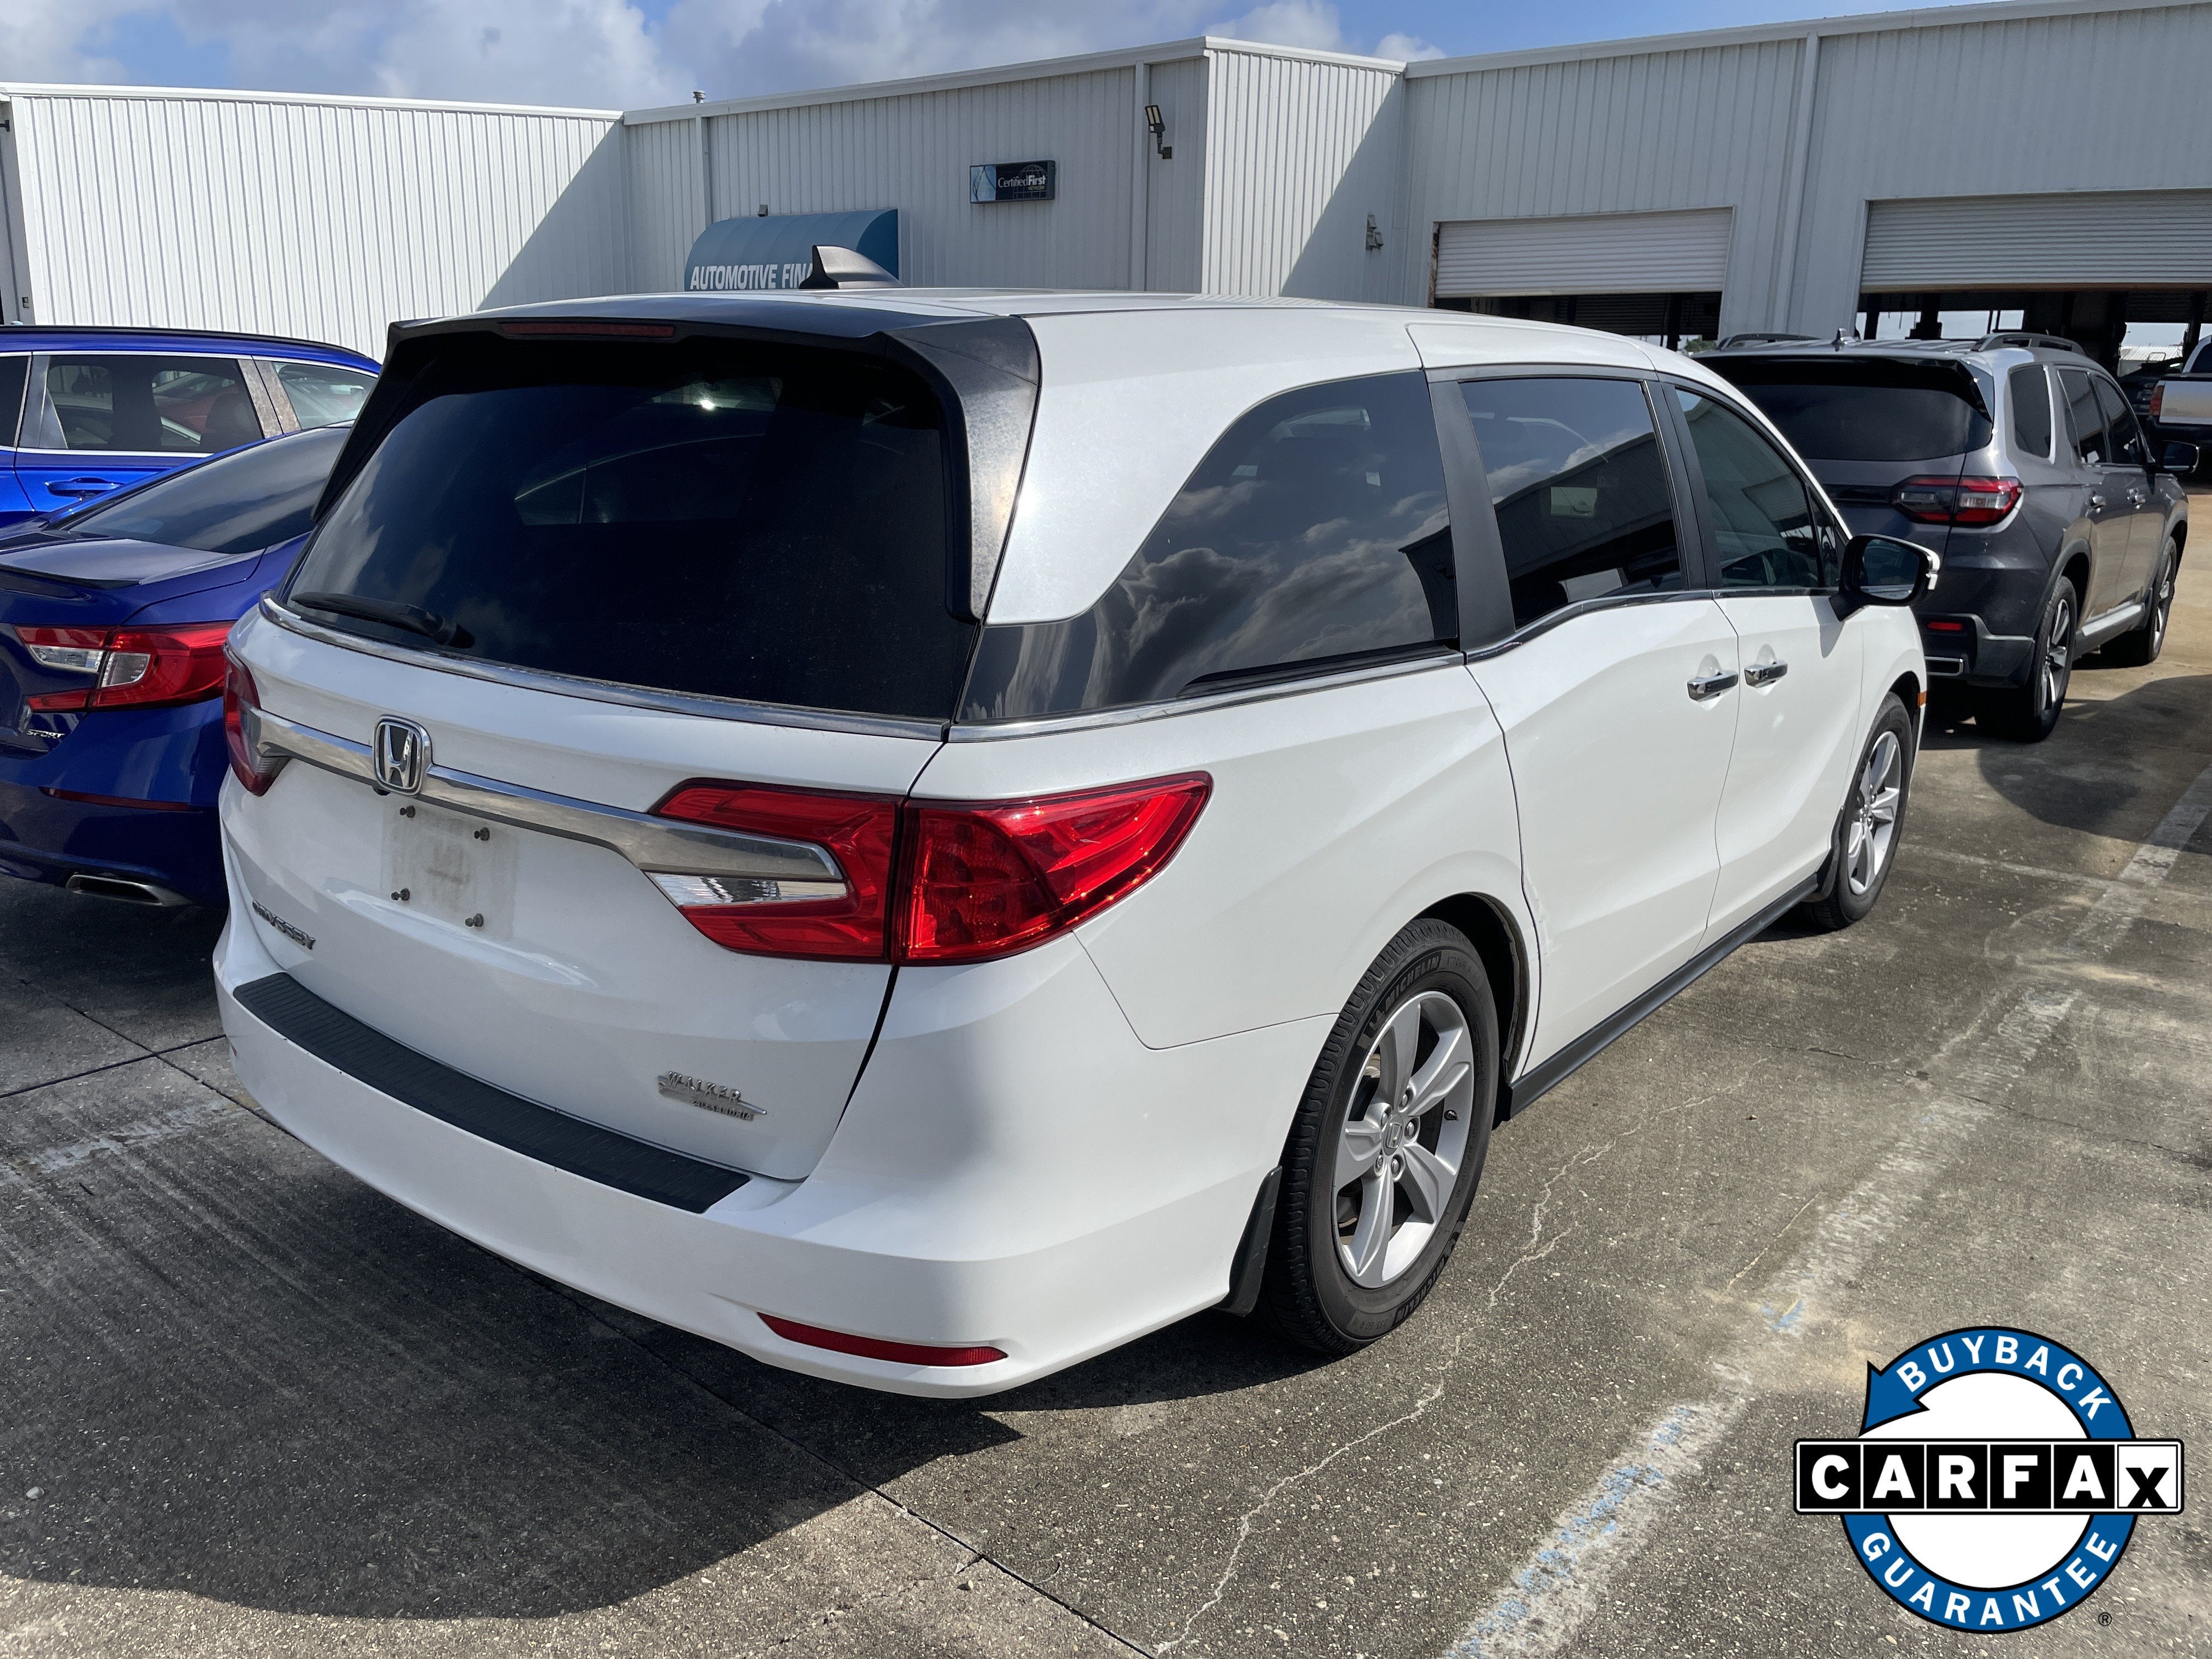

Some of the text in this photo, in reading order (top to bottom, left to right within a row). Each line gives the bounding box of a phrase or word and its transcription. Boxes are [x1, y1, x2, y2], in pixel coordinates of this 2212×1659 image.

[690, 264, 778, 290] AUTOMOTIVE
[26, 729, 65, 739] SPORT
[1385, 955, 1440, 1011] MICHELIN
[667, 1070, 741, 1104] WALKER
